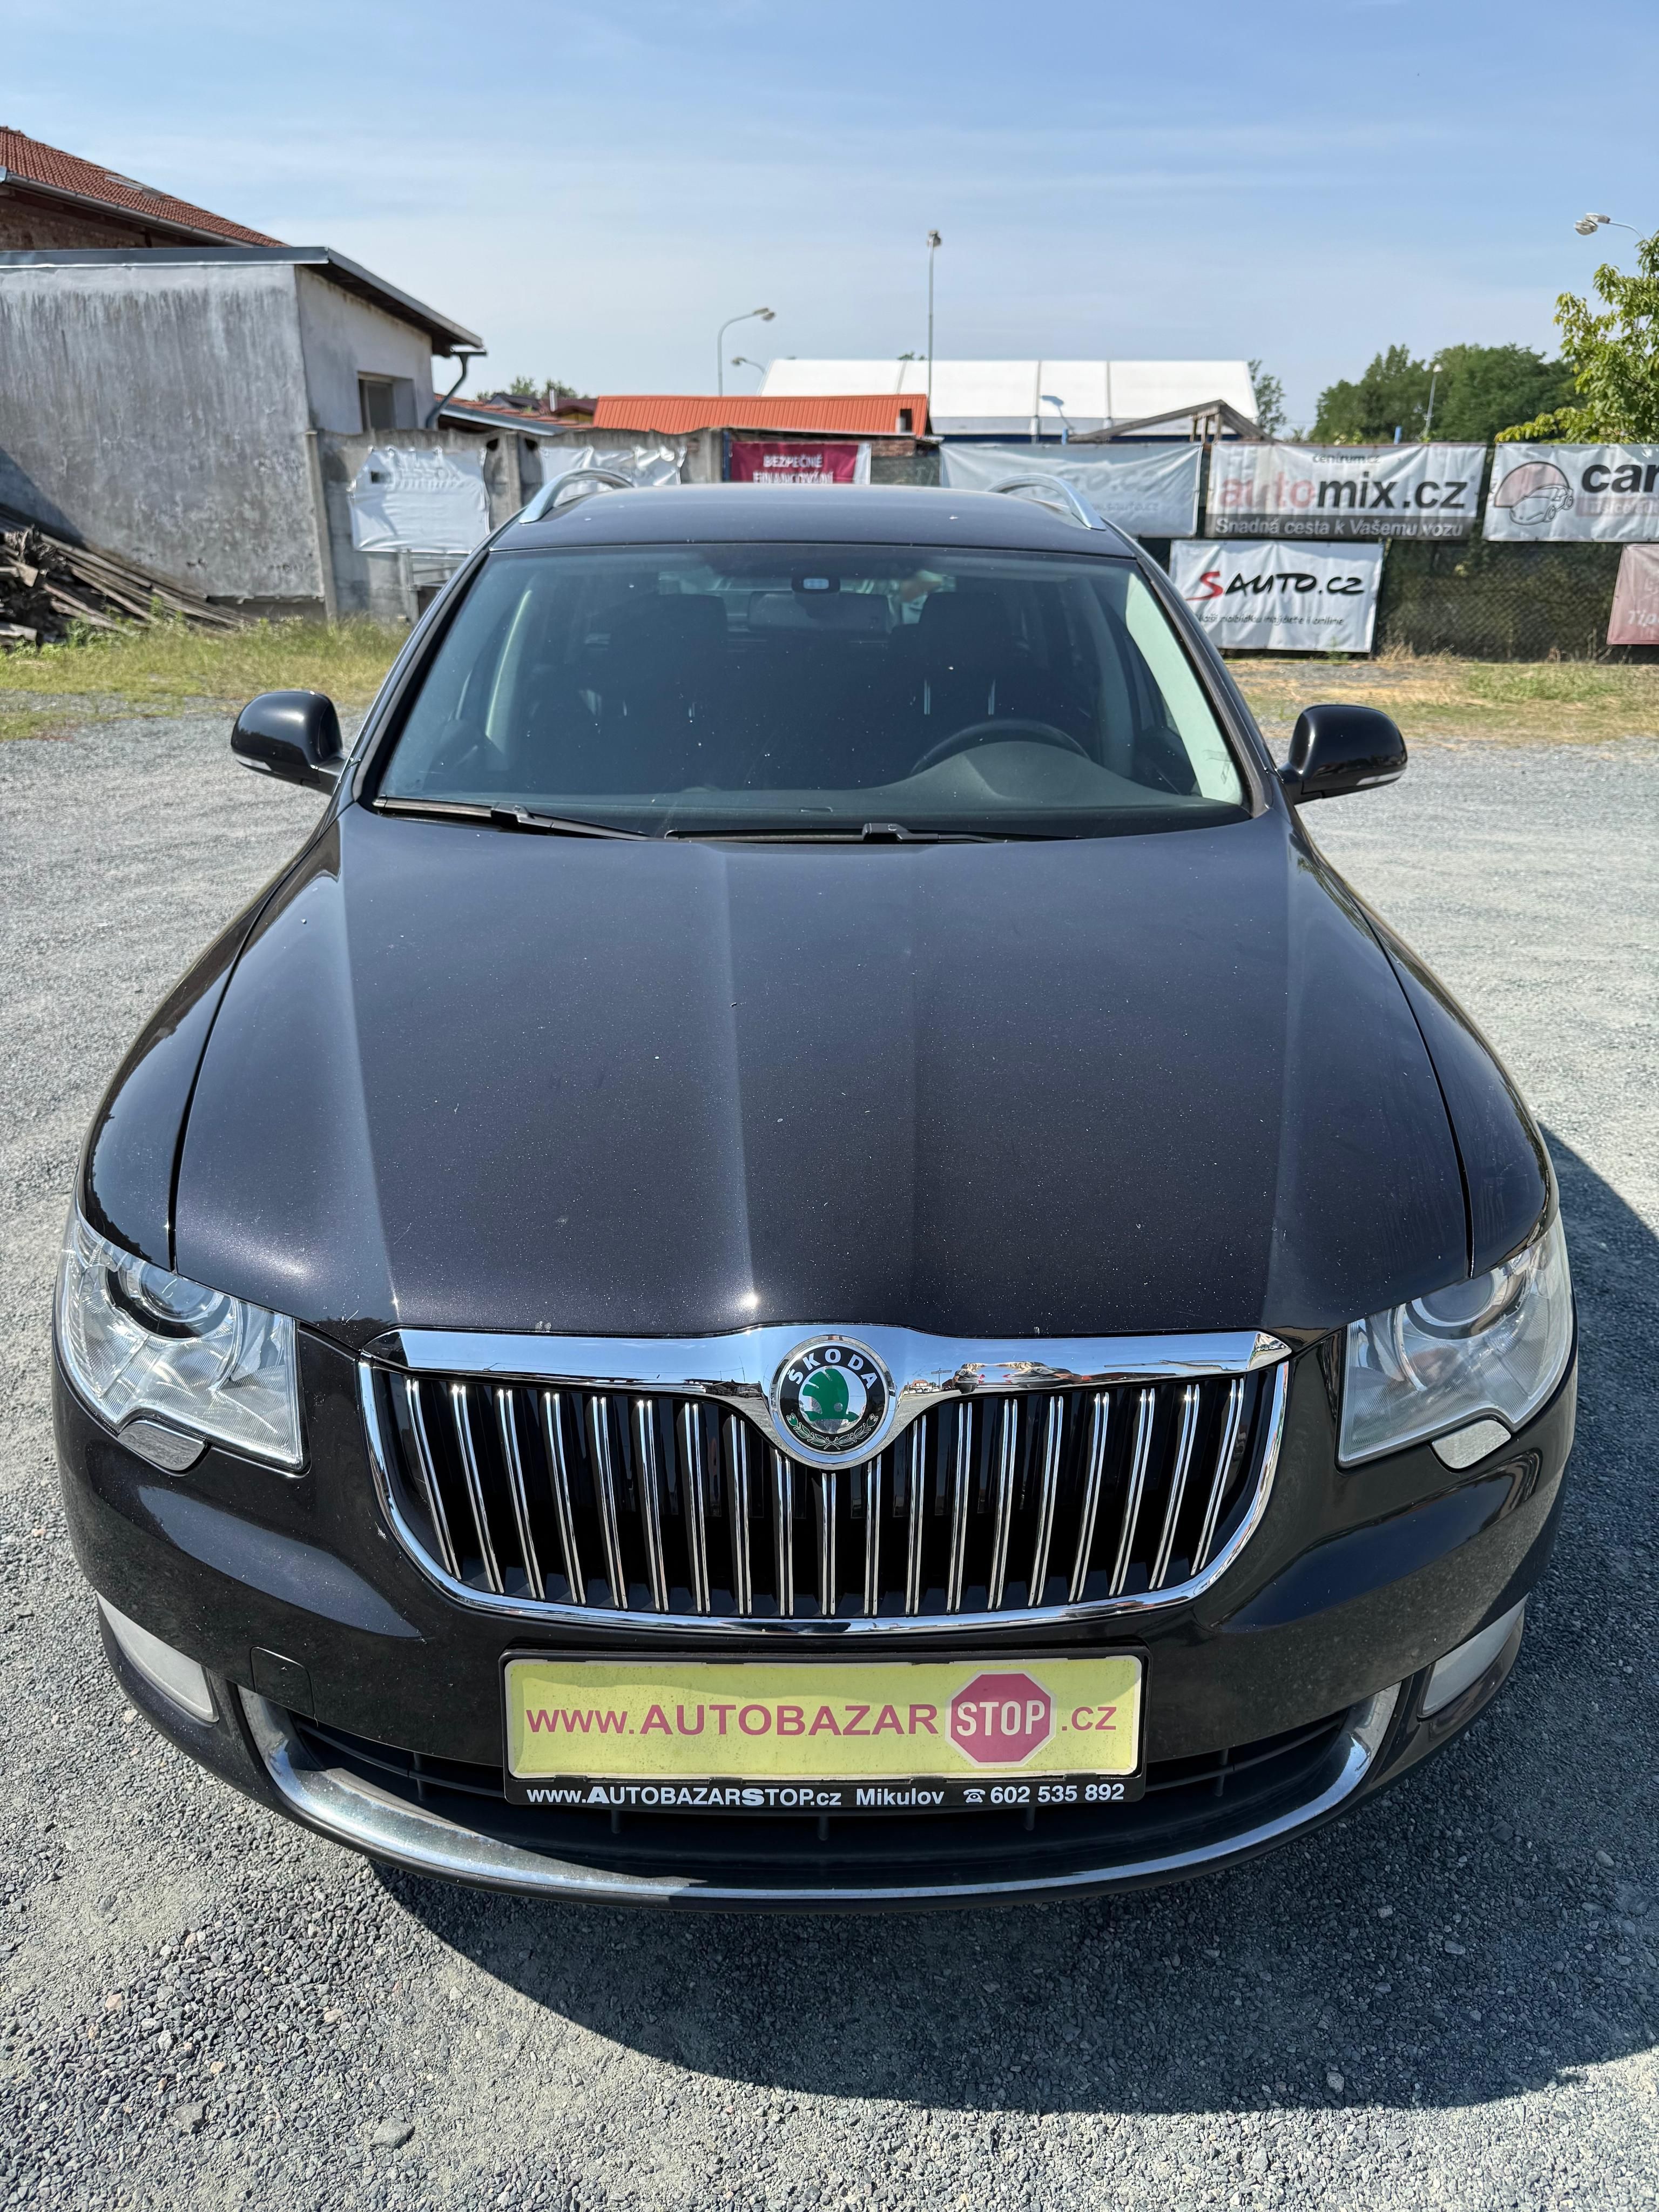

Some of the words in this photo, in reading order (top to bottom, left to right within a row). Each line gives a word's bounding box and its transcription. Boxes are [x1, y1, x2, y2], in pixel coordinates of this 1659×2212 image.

[1220, 471, 1468, 509] automix.cz
[1216, 517, 1280, 534] Snadná
[1284, 520, 1330, 535] cesta
[1334, 520, 1345, 535] k
[1350, 518, 1418, 536] Vašemu
[1421, 524, 1463, 536] vozu
[855, 1788, 945, 1806] Mikulov
[990, 1785, 1030, 1804] 602
[1037, 1784, 1078, 1803] 535
[1084, 1783, 1125, 1802] 892
